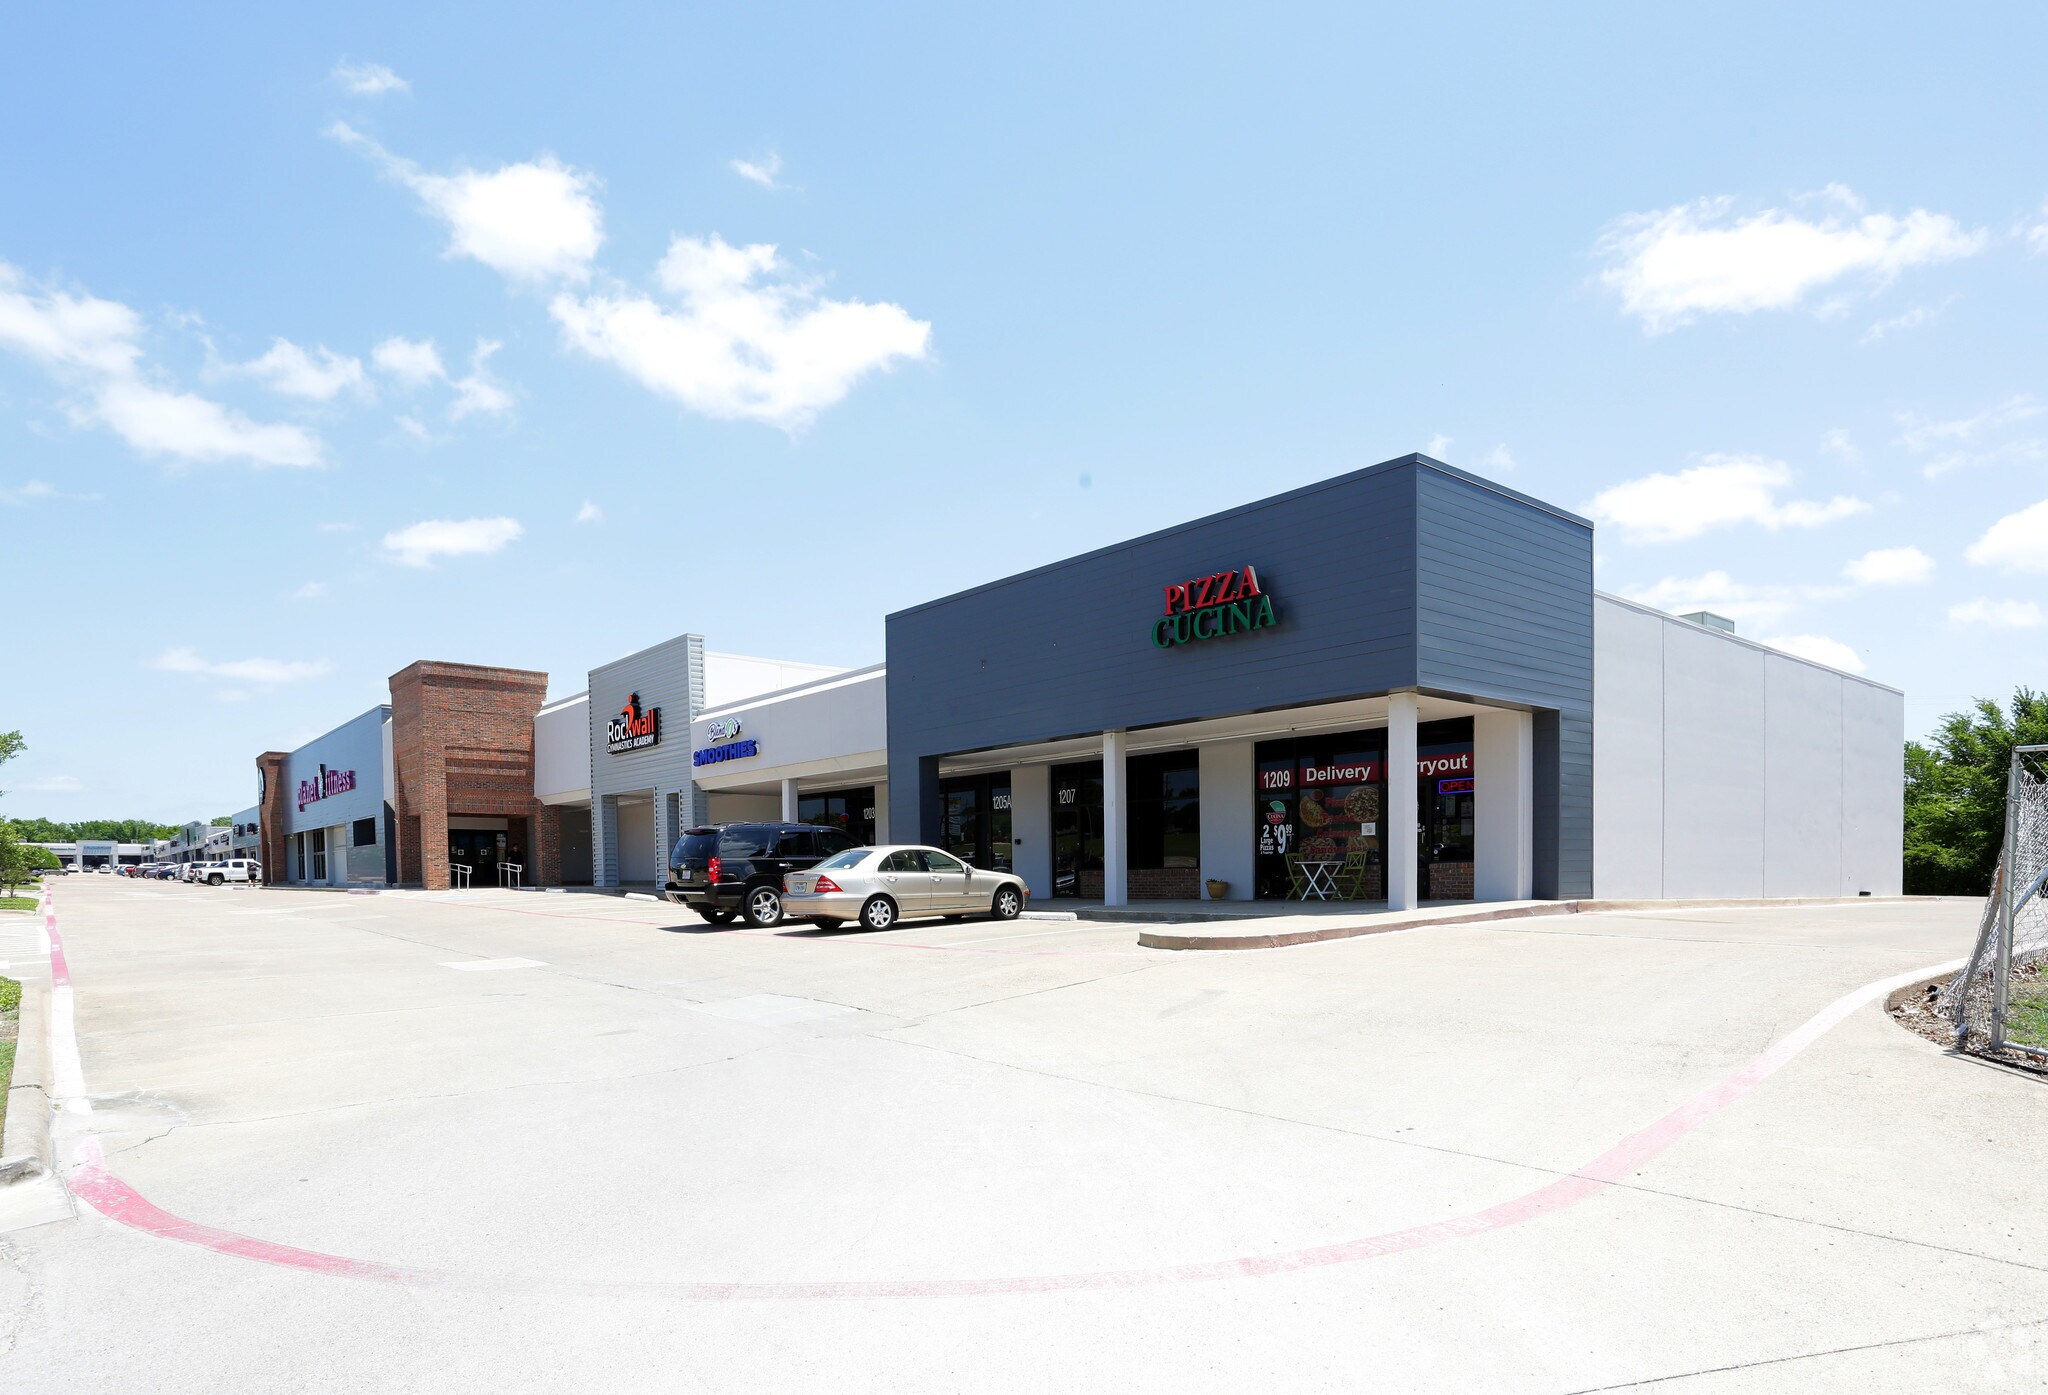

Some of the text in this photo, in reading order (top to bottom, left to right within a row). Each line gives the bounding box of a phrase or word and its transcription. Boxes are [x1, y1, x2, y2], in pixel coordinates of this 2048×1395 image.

[1163, 565, 1261, 616] PIZZA
[1152, 595, 1277, 648] CUCINA
[693, 740, 757, 767] SMOOTHIES
[1263, 769, 1291, 789] 1209
[1306, 754, 1468, 781] Delivery ryout
[1058, 788, 1076, 804] 1207
[1441, 780, 1475, 792] OPEN
[1263, 824, 1270, 838] 2
